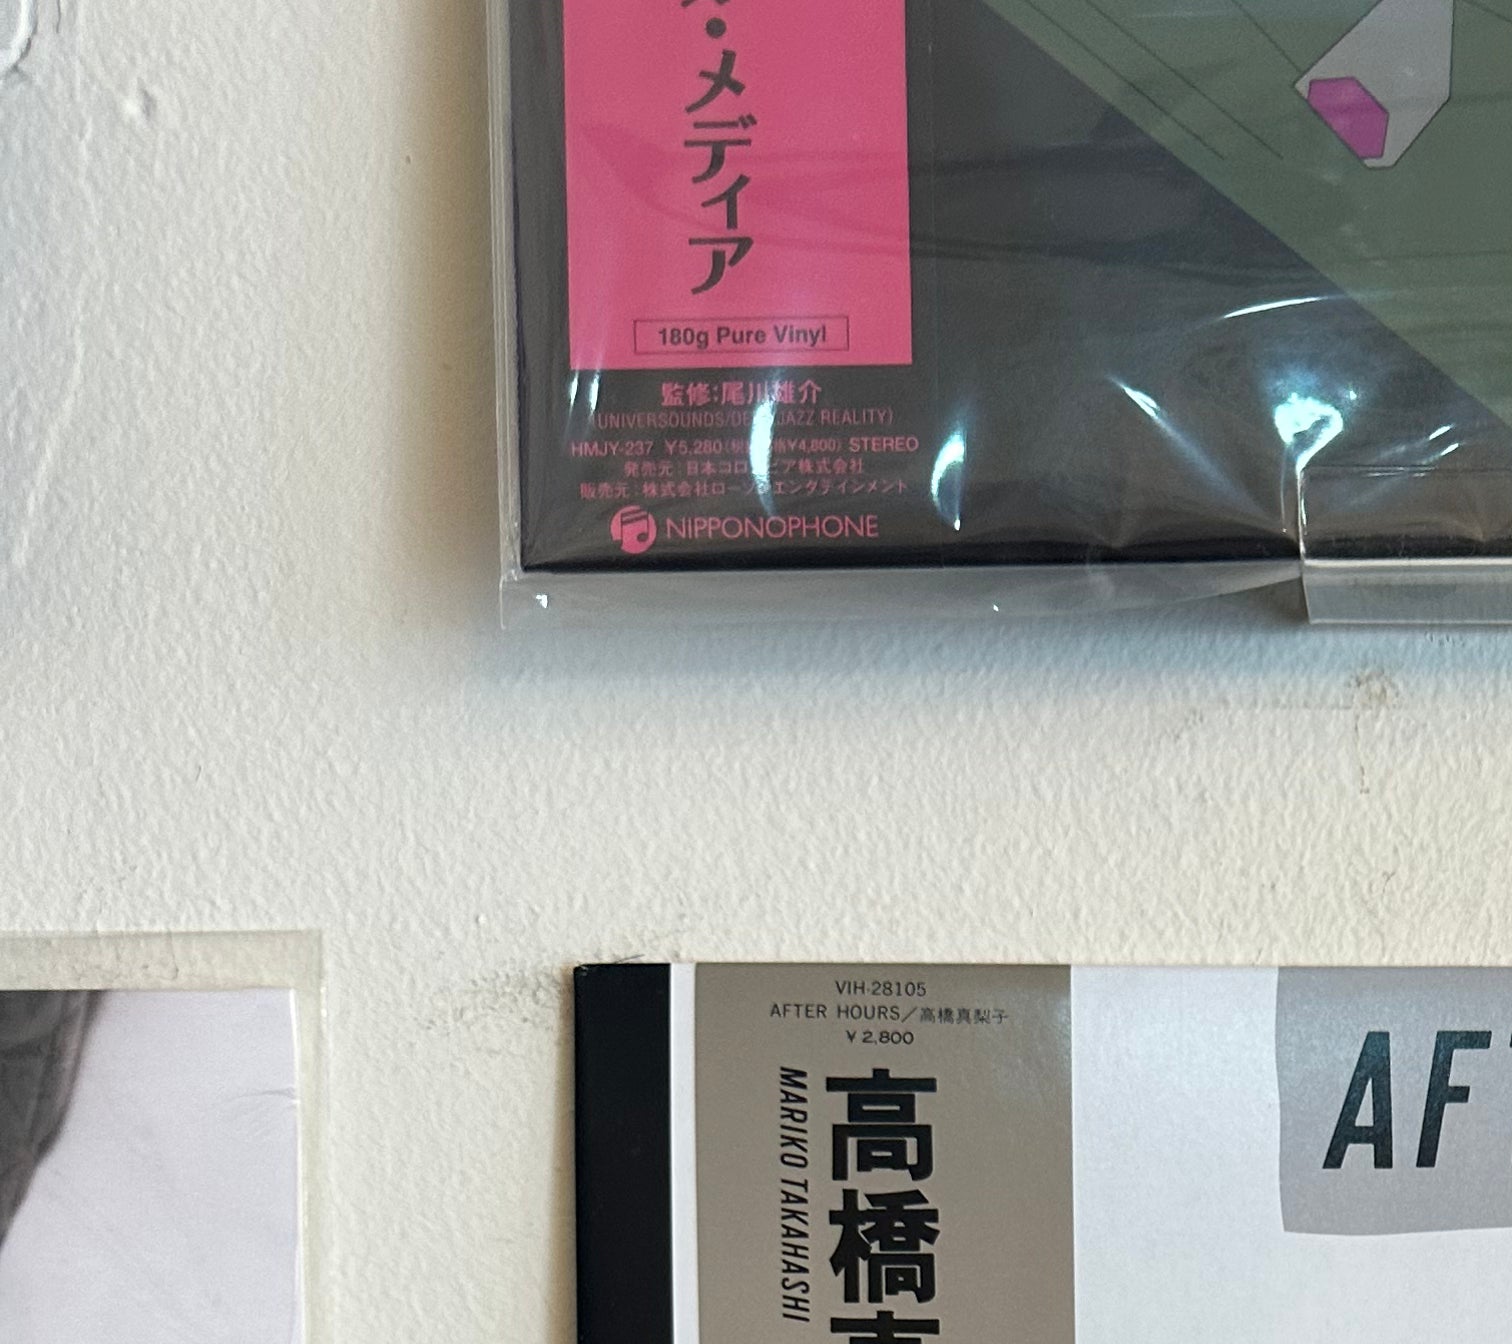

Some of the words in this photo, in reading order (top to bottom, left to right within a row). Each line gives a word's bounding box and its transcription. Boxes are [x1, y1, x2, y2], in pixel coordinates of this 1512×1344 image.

[678, 0, 758, 295] ・メディア
[658, 326, 710, 348] 180g
[716, 325, 767, 344] Pure
[773, 324, 827, 347] Vinyl
[571, 440, 654, 458] HMJY-237
[849, 436, 919, 453] STEREO
[665, 514, 879, 541] NIPPONOPHONE
[770, 1003, 827, 1020] AFTER
[779, 1066, 808, 1168] MARIKO
[780, 1179, 810, 1323] TAKAHASHI
